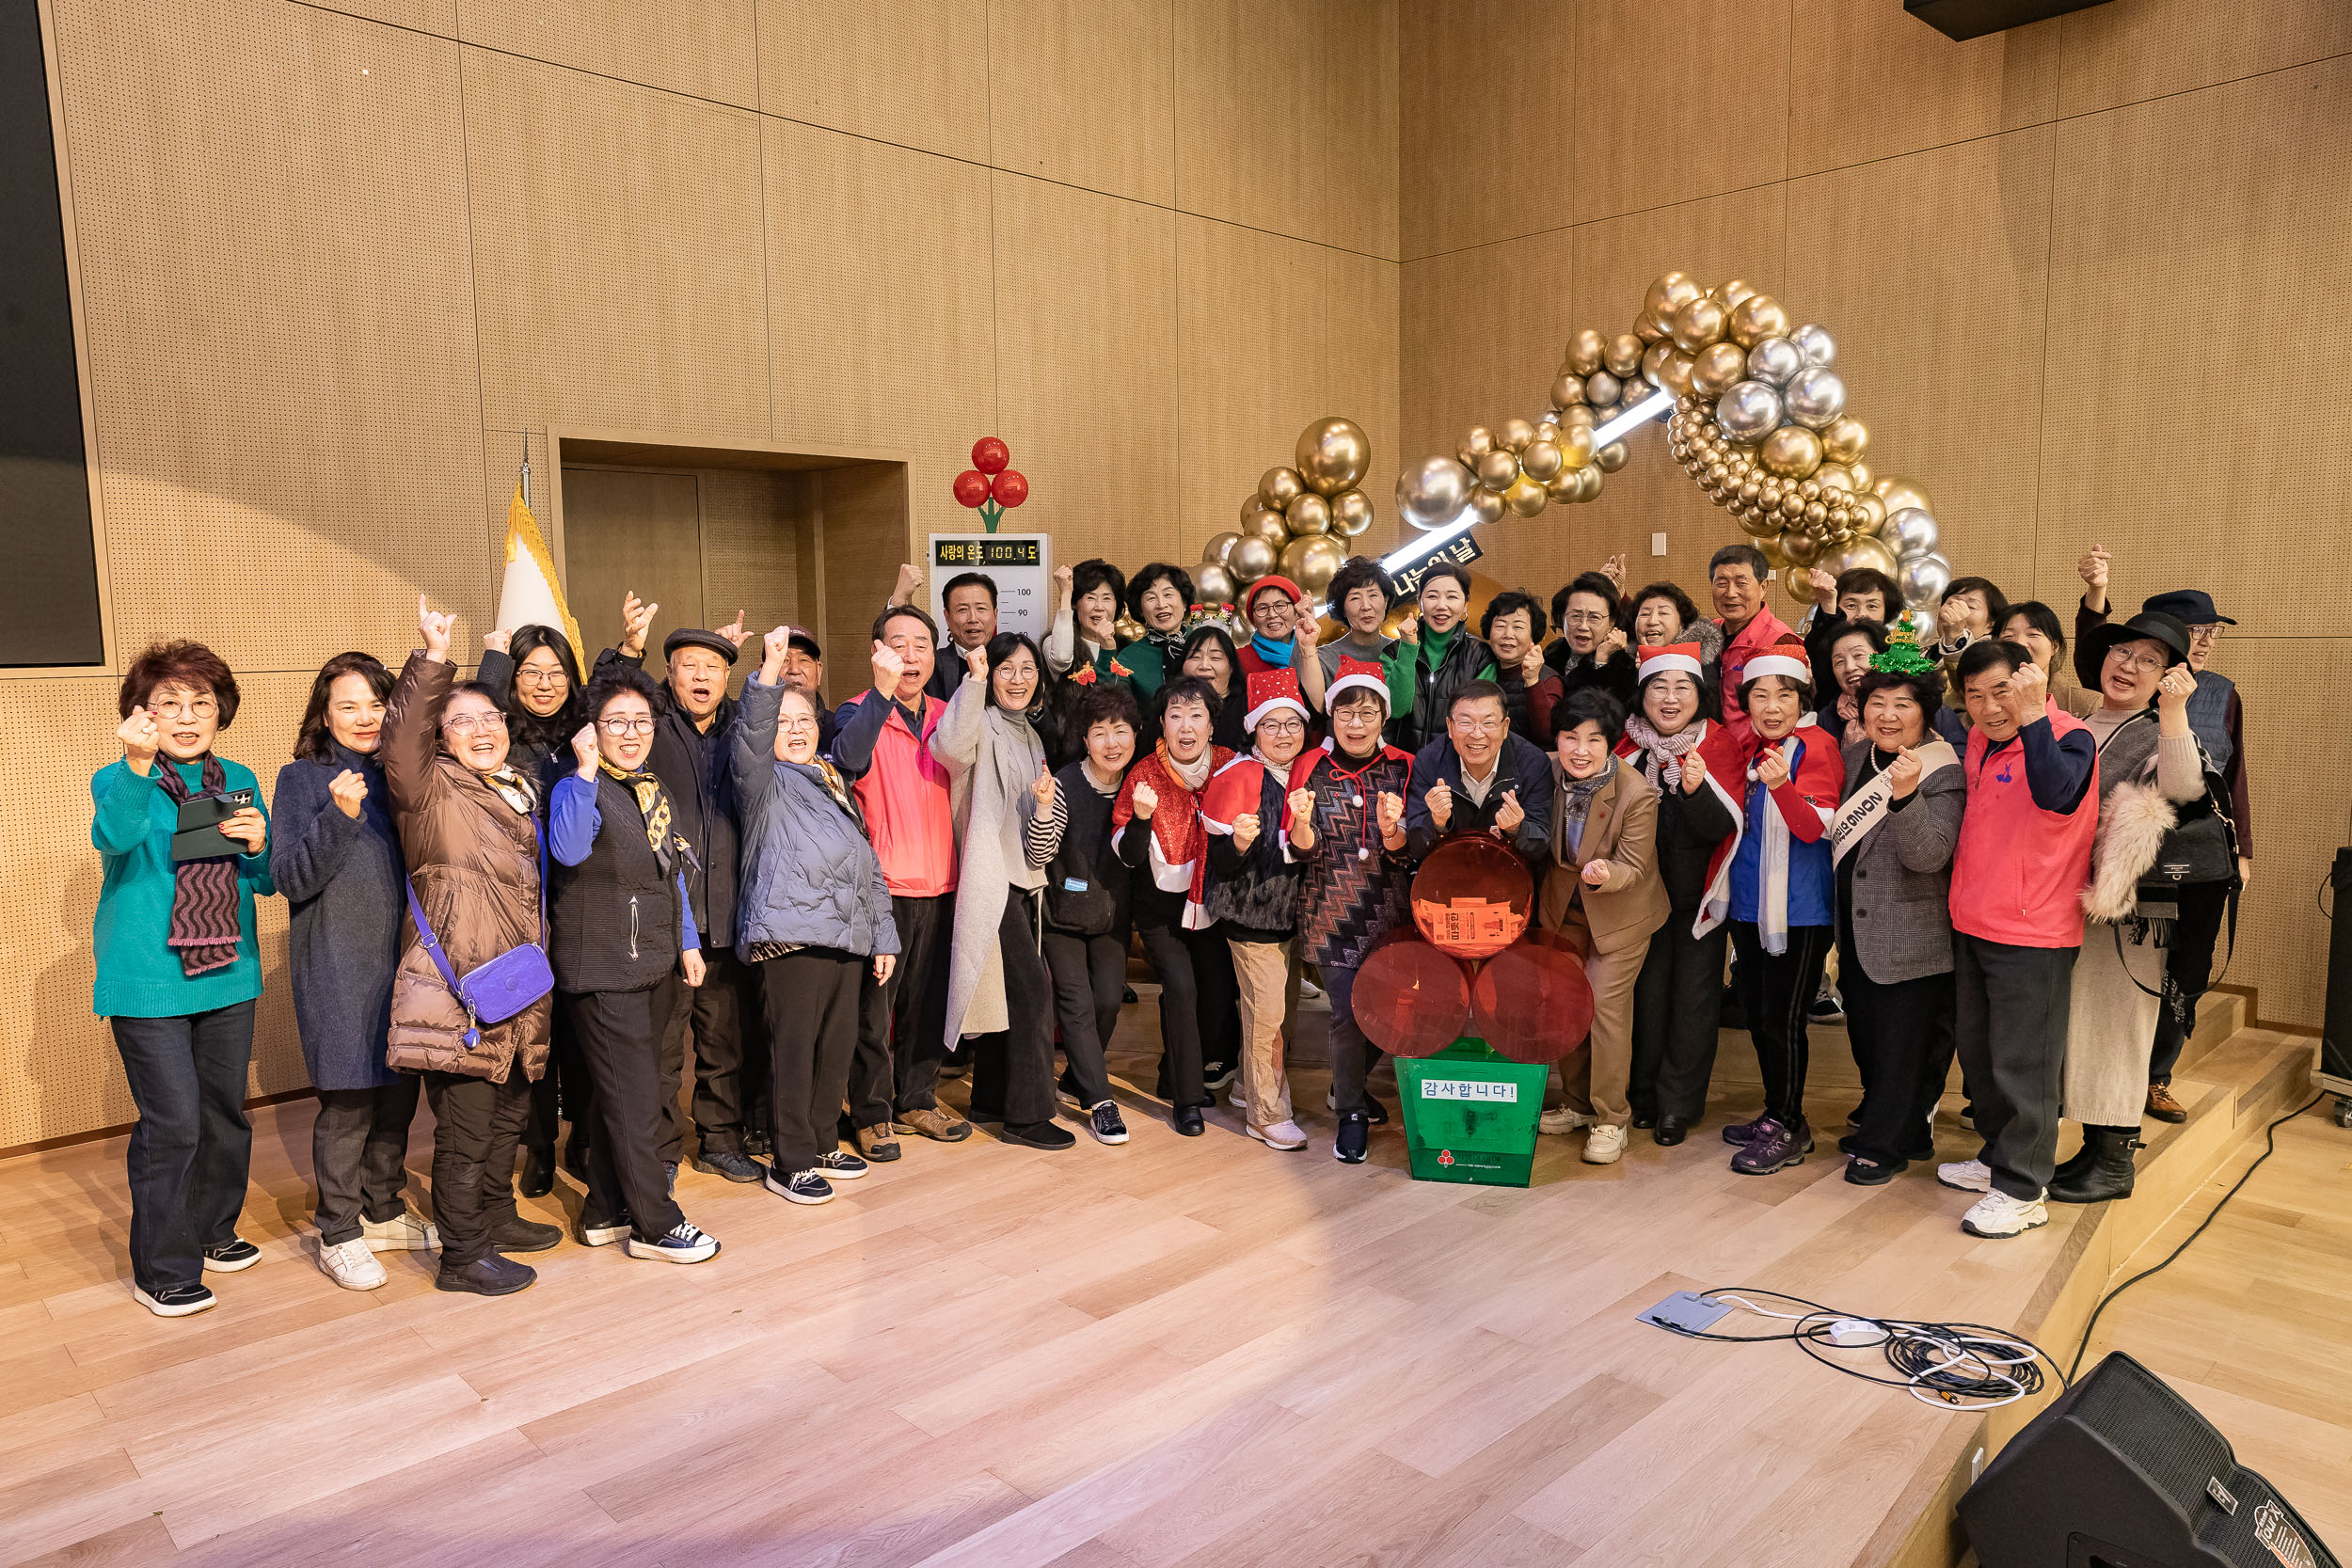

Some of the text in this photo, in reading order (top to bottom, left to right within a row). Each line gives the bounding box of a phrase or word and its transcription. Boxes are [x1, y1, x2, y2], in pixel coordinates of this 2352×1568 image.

[940, 545, 964, 560] 사랑의
[967, 545, 983, 560] 온도
[1027, 546, 1036, 560] 도
[1449, 537, 1476, 563] 날
[1423, 1082, 1514, 1098] 감사합니다!
[2258, 1514, 2277, 1544] Tour
